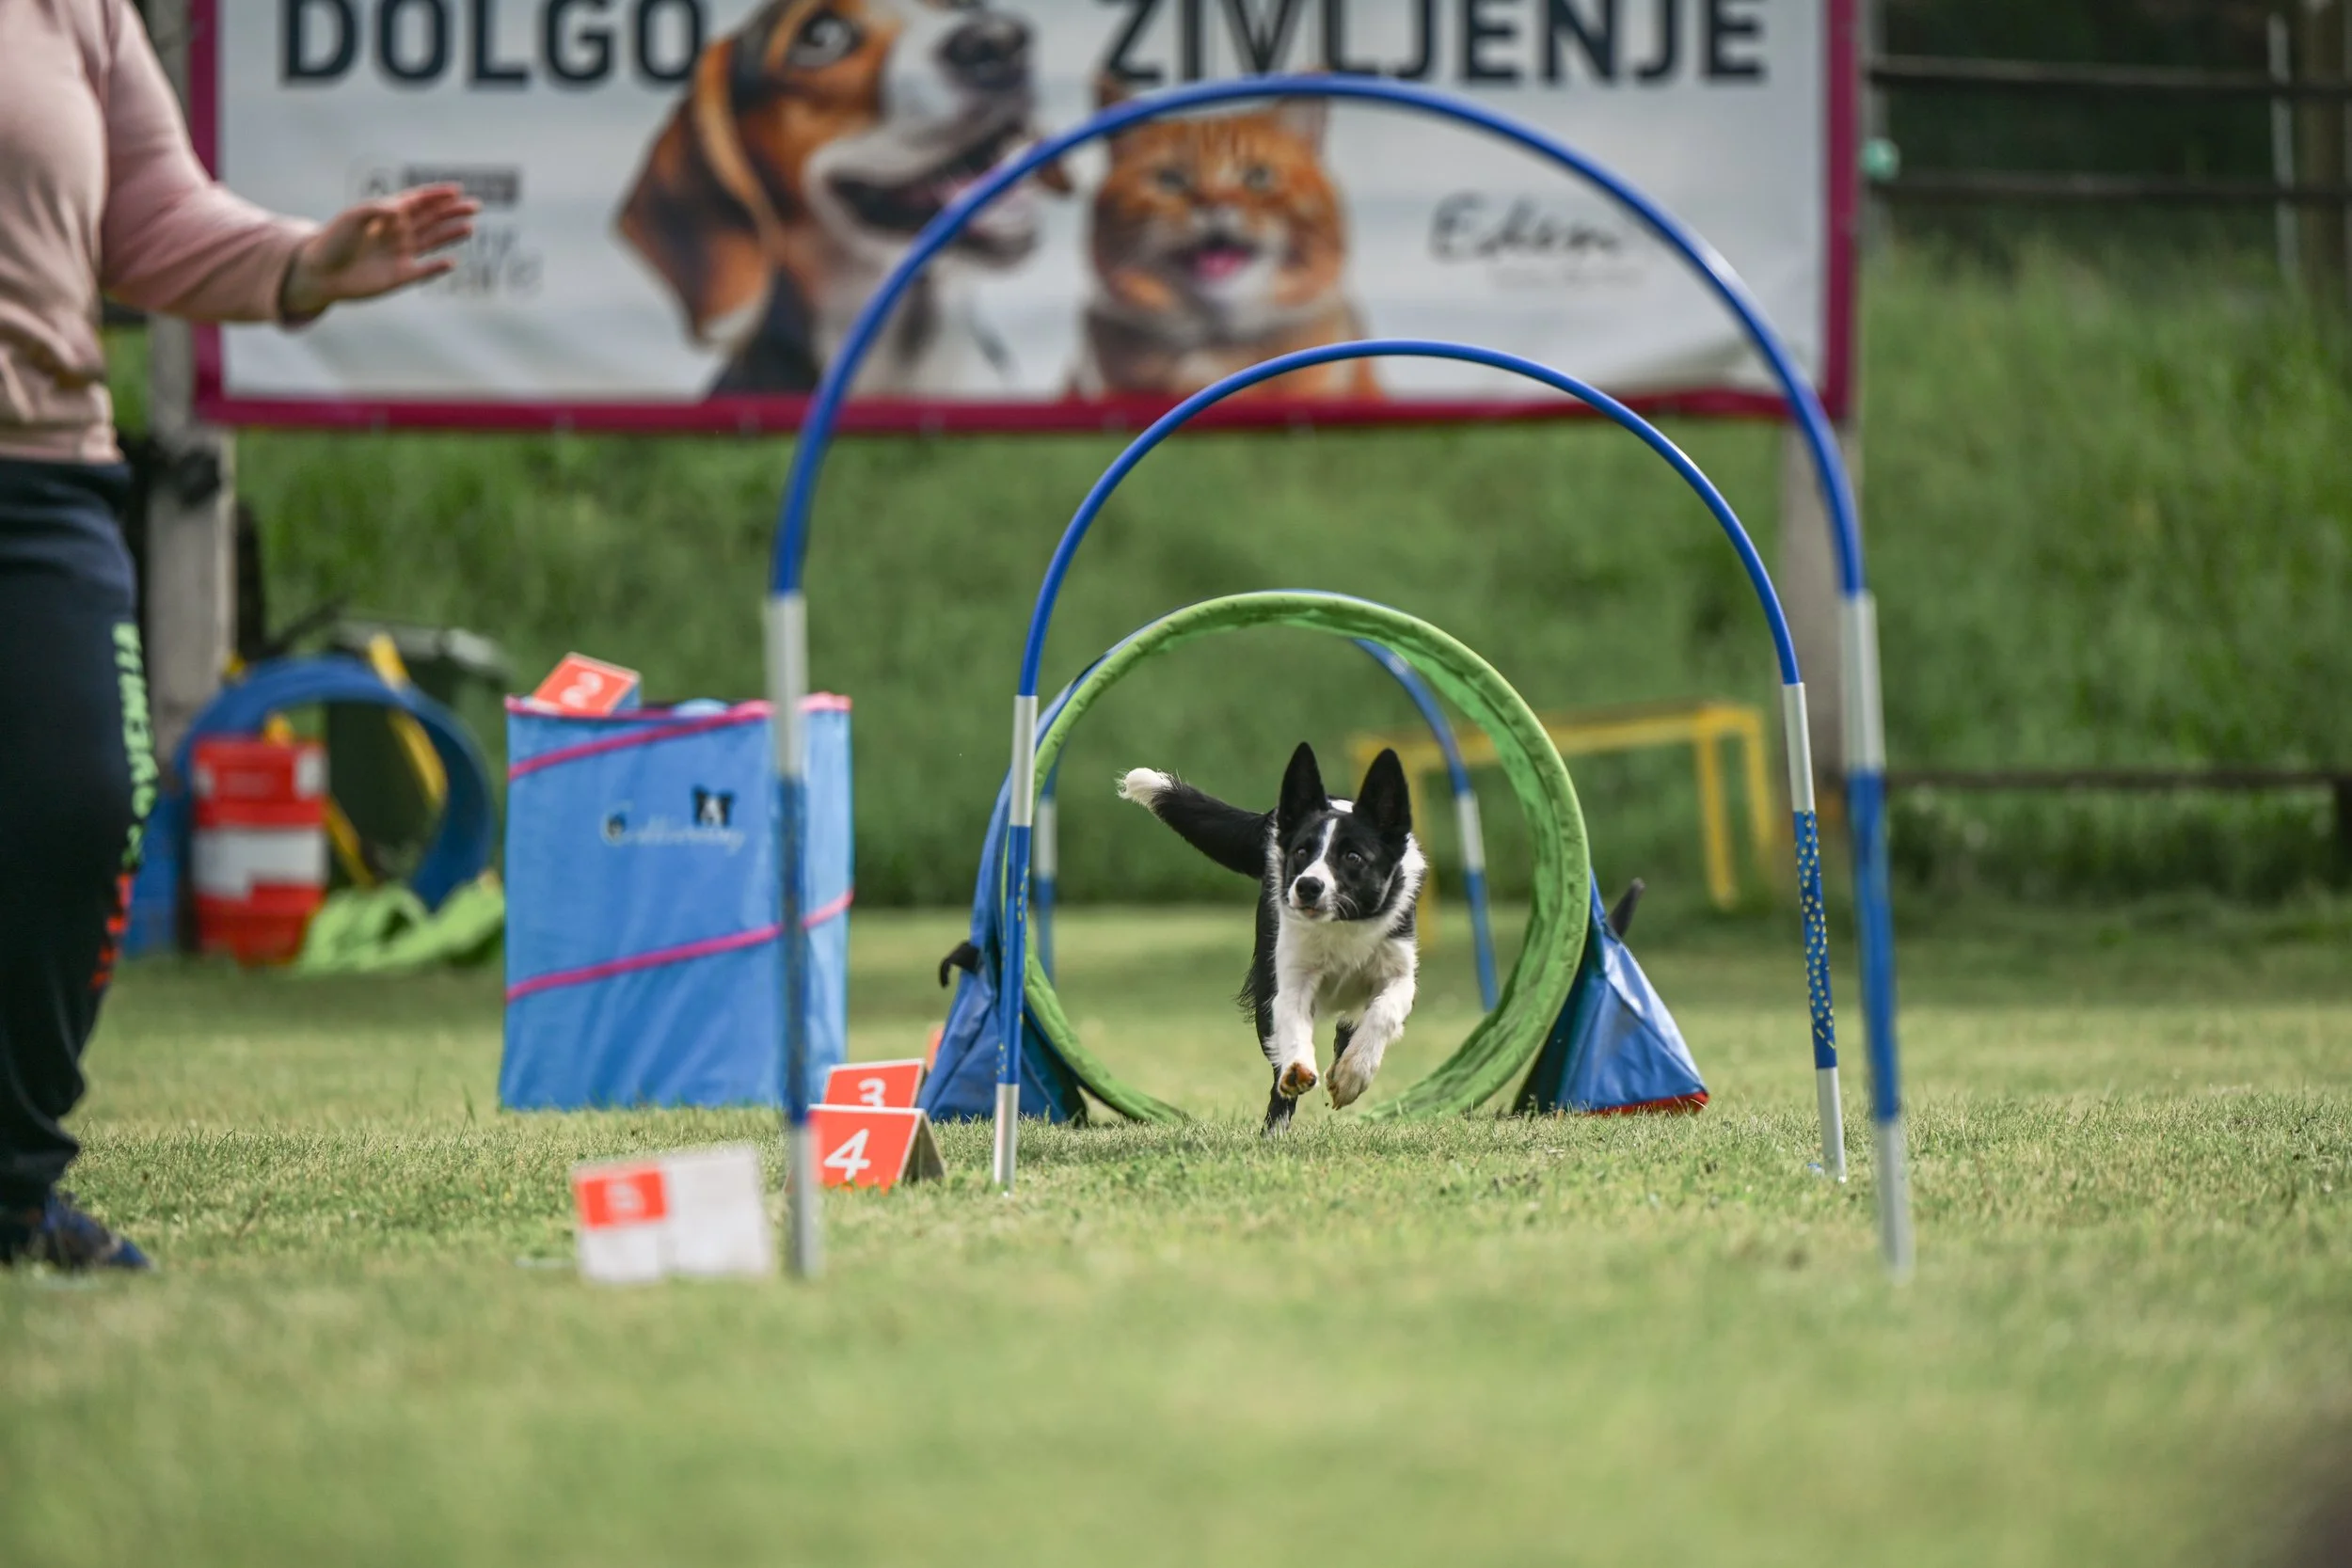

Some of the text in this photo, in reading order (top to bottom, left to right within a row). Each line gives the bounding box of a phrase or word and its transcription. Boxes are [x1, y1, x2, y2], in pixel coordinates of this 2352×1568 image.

[279, 0, 704, 84] DOLGO
[559, 671, 603, 710] 2
[858, 1078, 886, 1108] 3
[823, 1129, 871, 1180] 4
